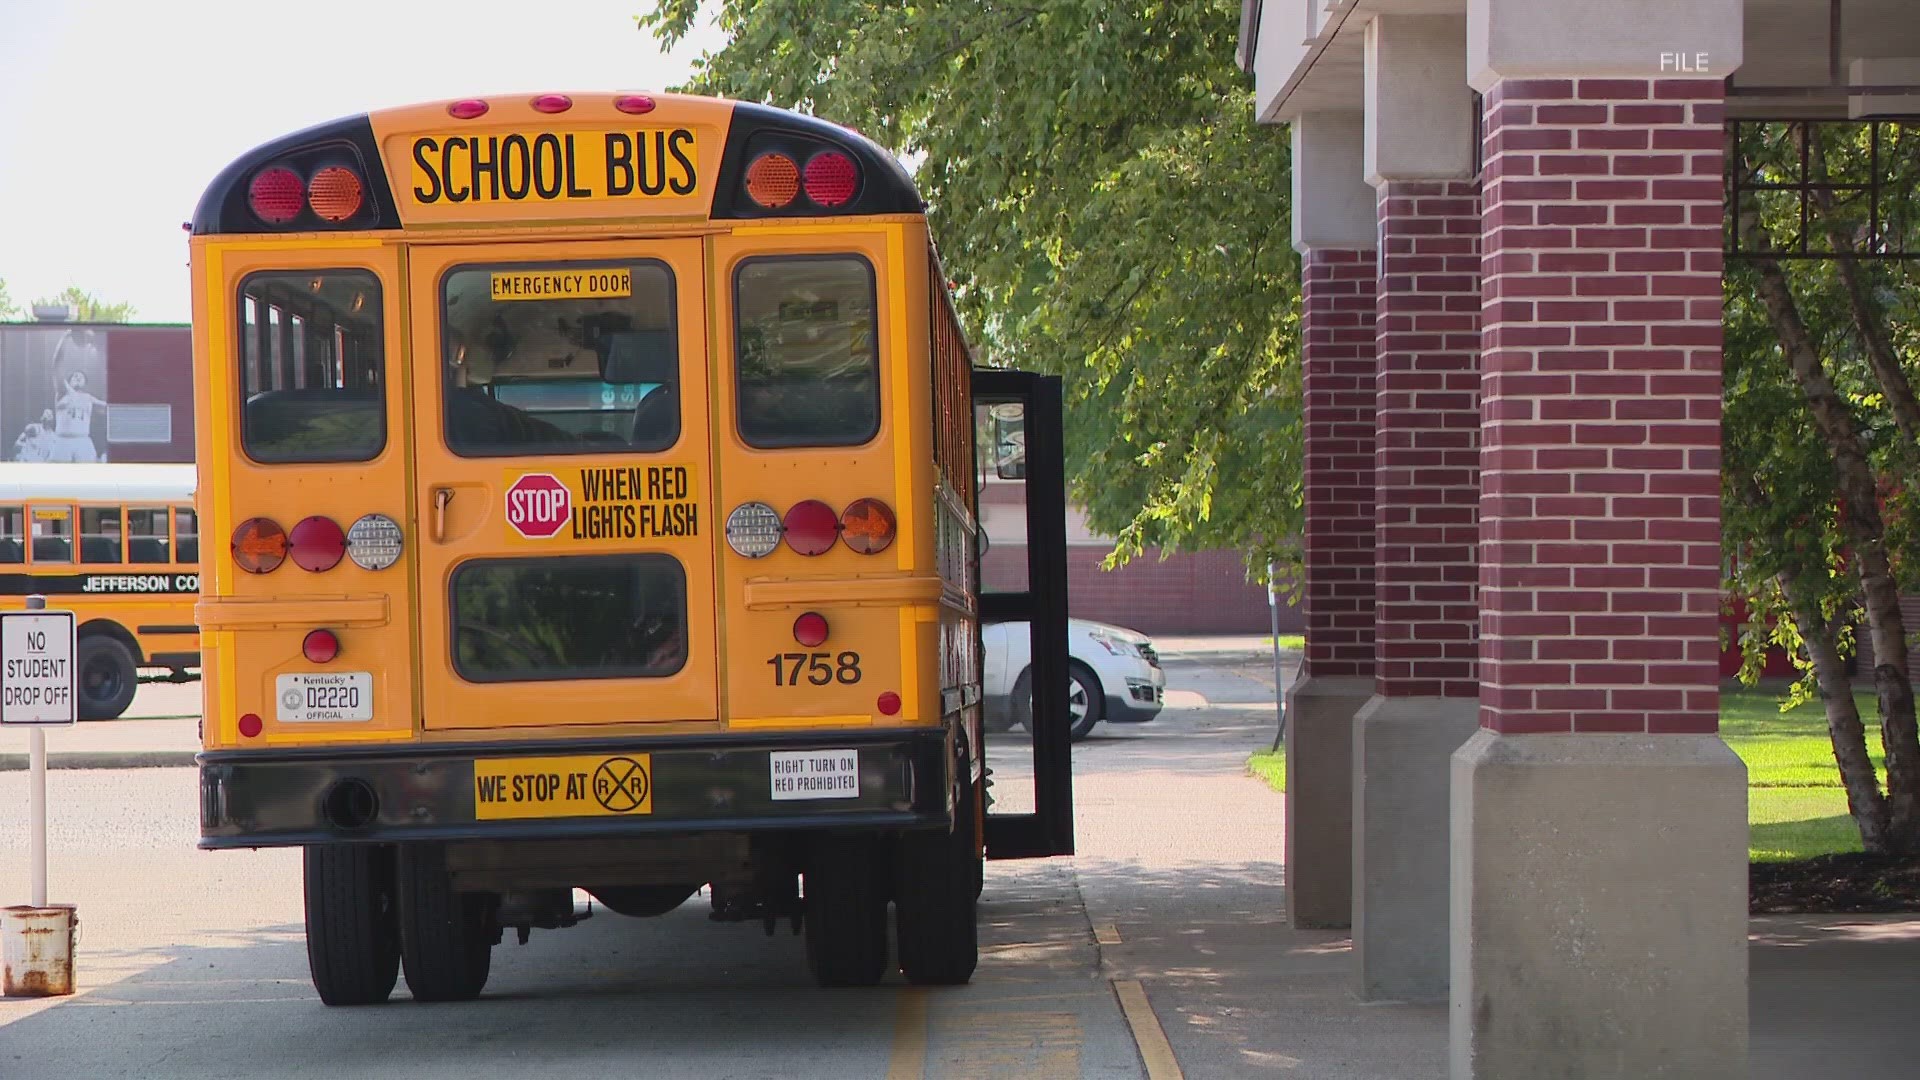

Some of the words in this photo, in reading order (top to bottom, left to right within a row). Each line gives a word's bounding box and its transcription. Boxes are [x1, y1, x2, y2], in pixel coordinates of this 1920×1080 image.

[412, 133, 592, 203] SCHOOL
[604, 129, 696, 196] BUS
[492, 276, 583, 295] EMERGENCY
[589, 274, 630, 292] DOOR
[581, 467, 641, 501] WHEN
[648, 466, 687, 500] RED
[511, 489, 565, 523] STOP
[572, 505, 636, 539] LIGHTS
[640, 503, 698, 537] FLASH
[82, 575, 169, 592] JEFFERSON
[175, 575, 200, 591] CO
[27, 631, 46, 650] NO
[7, 659, 66, 678] STUDENT
[766, 651, 862, 686] 1758
[303, 676, 346, 685] Kentucky
[5, 687, 41, 706] DROP
[44, 687, 69, 705] OFF
[307, 687, 359, 708] D2220
[306, 712, 343, 720] OFFICIAL
[774, 760, 804, 774] RIGHT
[809, 758, 836, 772] TURN
[840, 757, 854, 771] ON
[477, 776, 507, 803] WE
[512, 774, 560, 802] STOP
[565, 773, 588, 800] AT
[775, 779, 793, 792] RED
[798, 776, 855, 791] PROHIBITED
